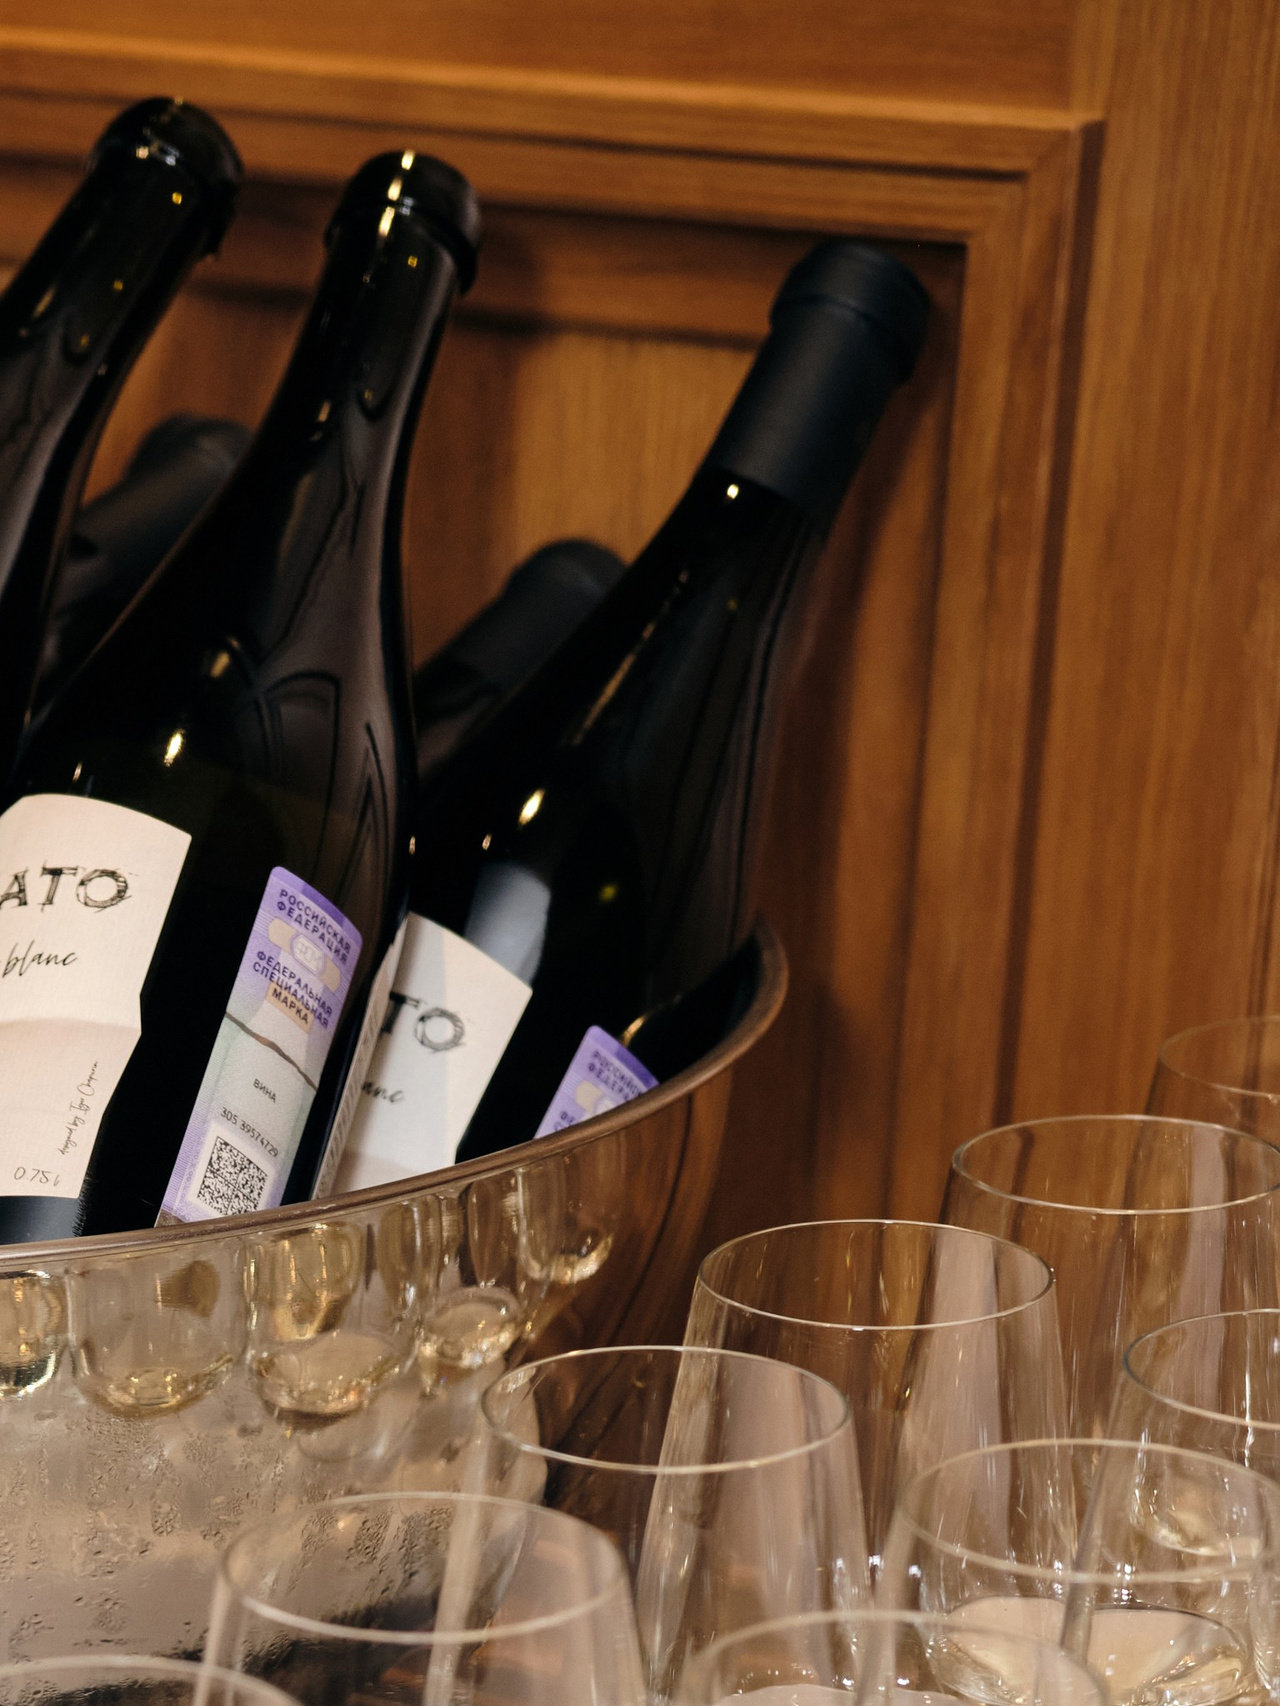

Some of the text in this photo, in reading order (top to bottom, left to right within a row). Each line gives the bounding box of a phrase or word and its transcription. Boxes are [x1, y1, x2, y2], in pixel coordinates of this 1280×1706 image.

[276, 900, 349, 965] ФЕДЕРАЦИЯ
[278, 888, 352, 955] РОССИЙСКАЯ
[1, 939, 78, 979] blanc
[256, 949, 333, 1018] ФЕДЕРАЛЬНАЯ
[252, 961, 330, 1031] СПЕЦИАЛЬНАЯ
[271, 988, 310, 1026] МАРКА
[219, 1106, 239, 1126] 305
[252, 1077, 278, 1104] ВИНА
